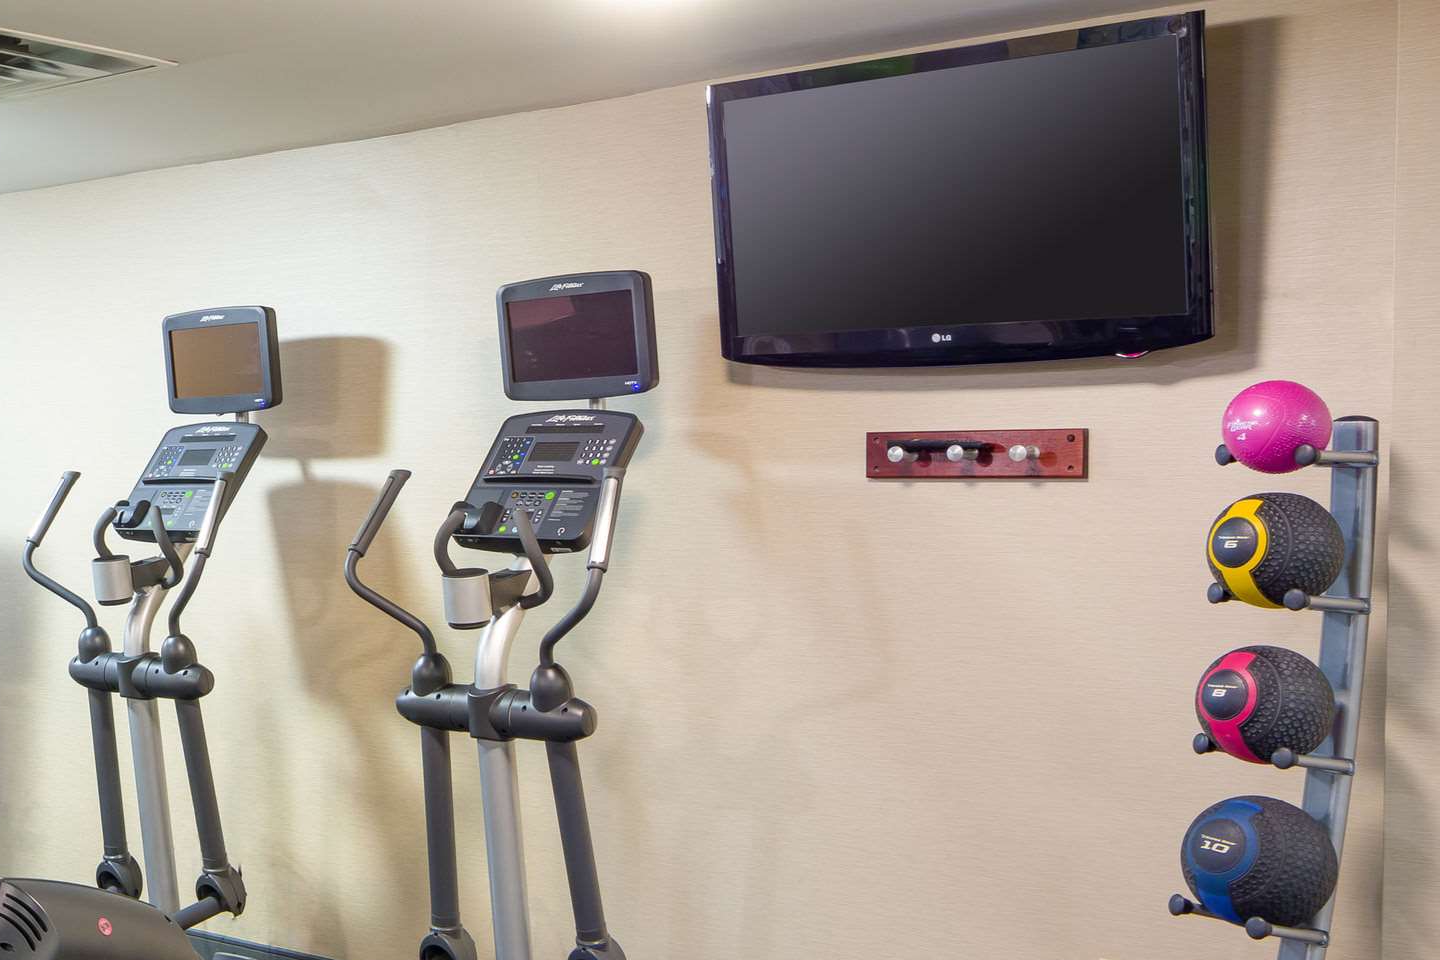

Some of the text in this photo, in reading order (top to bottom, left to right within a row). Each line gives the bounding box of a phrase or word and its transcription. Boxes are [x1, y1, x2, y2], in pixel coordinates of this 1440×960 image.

[941, 334, 952, 342] LG
[1236, 432, 1246, 441] 4
[1224, 540, 1239, 549] 6
[1212, 688, 1227, 698] 8
[1200, 840, 1230, 854] 10
